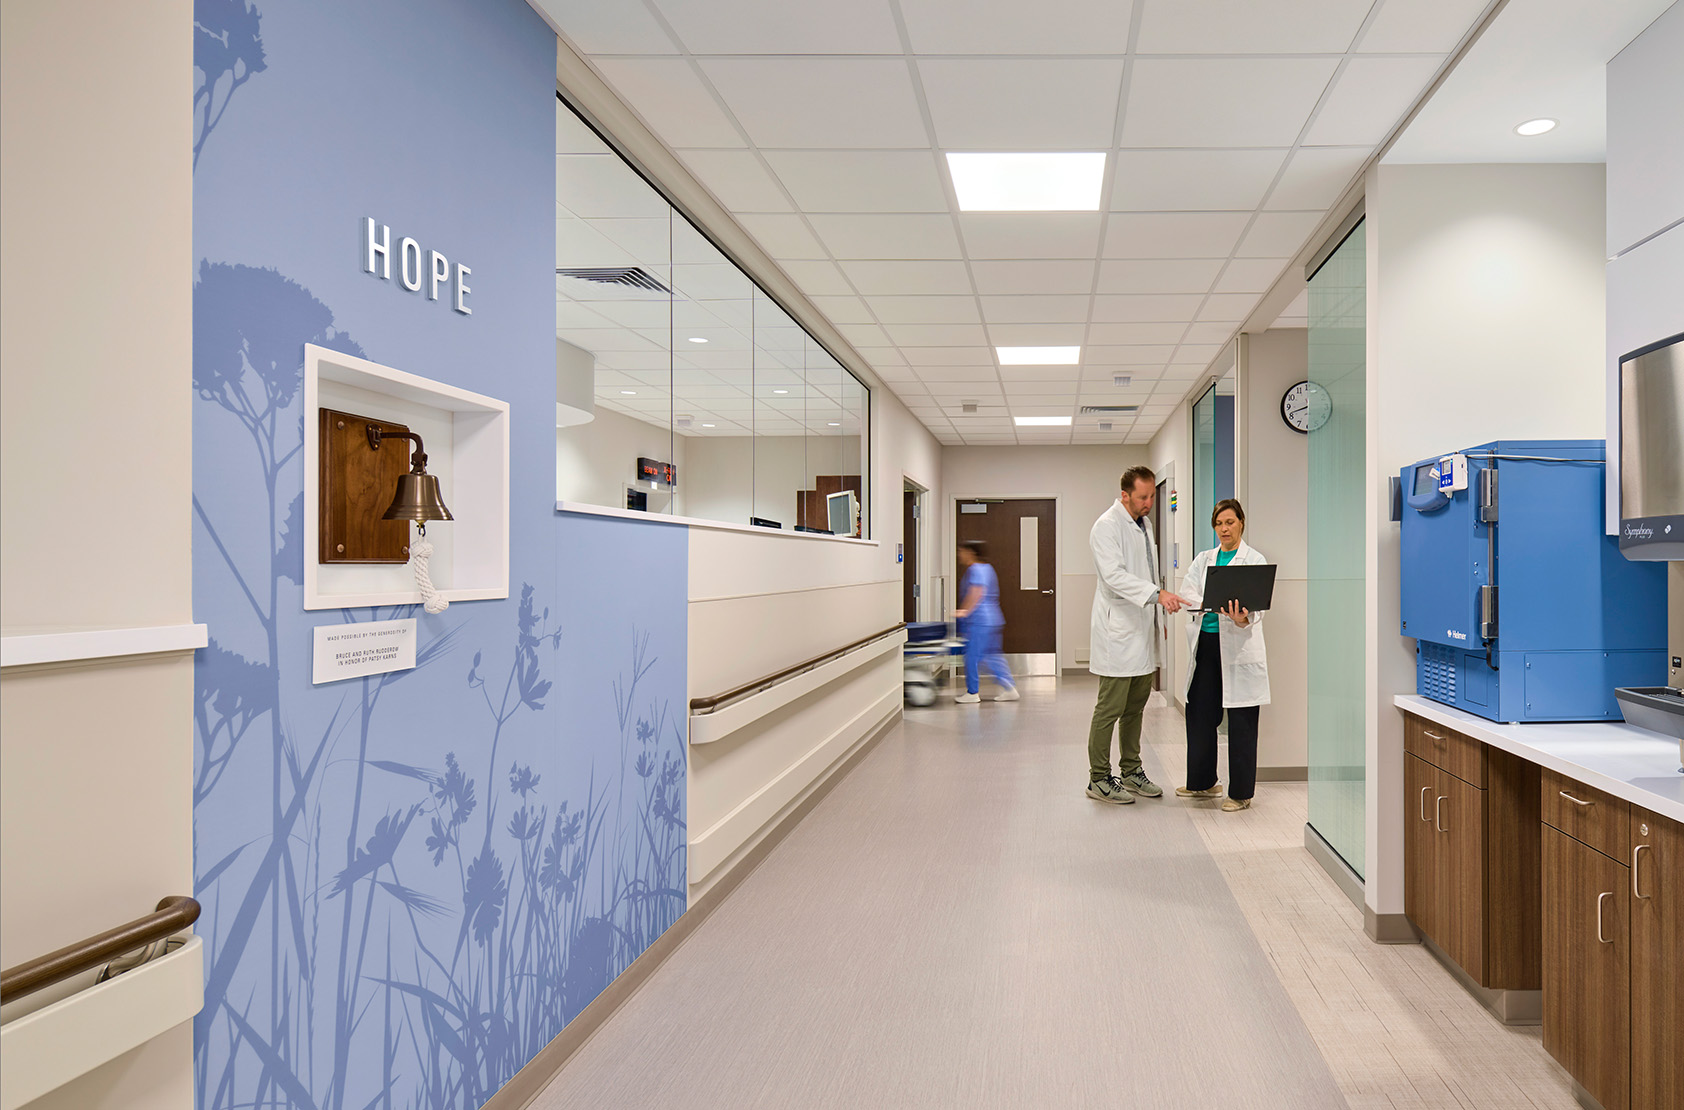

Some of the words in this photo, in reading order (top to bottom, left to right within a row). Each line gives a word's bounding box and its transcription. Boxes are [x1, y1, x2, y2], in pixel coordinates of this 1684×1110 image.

[363, 216, 472, 316] HOPE
[1286, 403, 1291, 411] 9
[1289, 412, 1294, 420] 8
[1624, 523, 1654, 539] Symphony
[1452, 630, 1467, 640] Helmer
